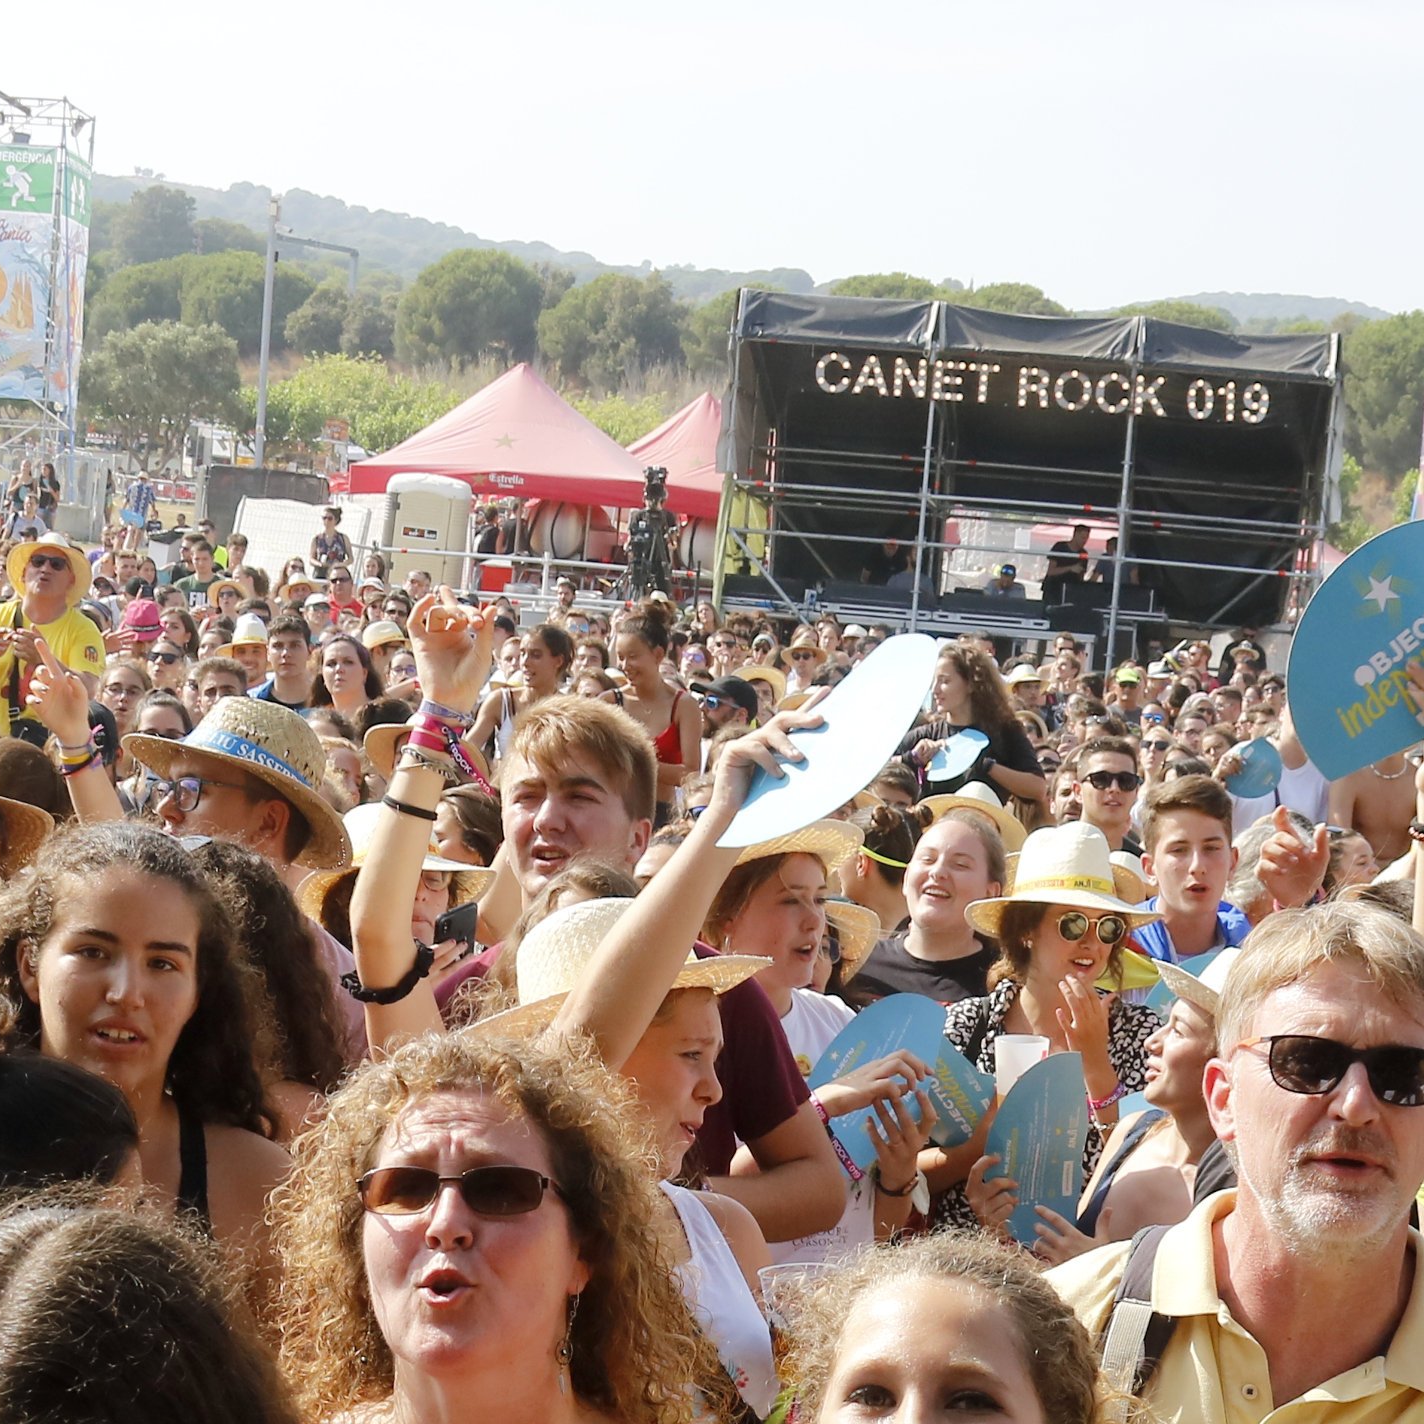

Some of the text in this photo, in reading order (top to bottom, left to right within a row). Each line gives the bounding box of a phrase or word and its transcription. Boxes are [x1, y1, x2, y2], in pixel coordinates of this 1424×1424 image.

[815, 352, 1270, 424] CANET ROCK 019
